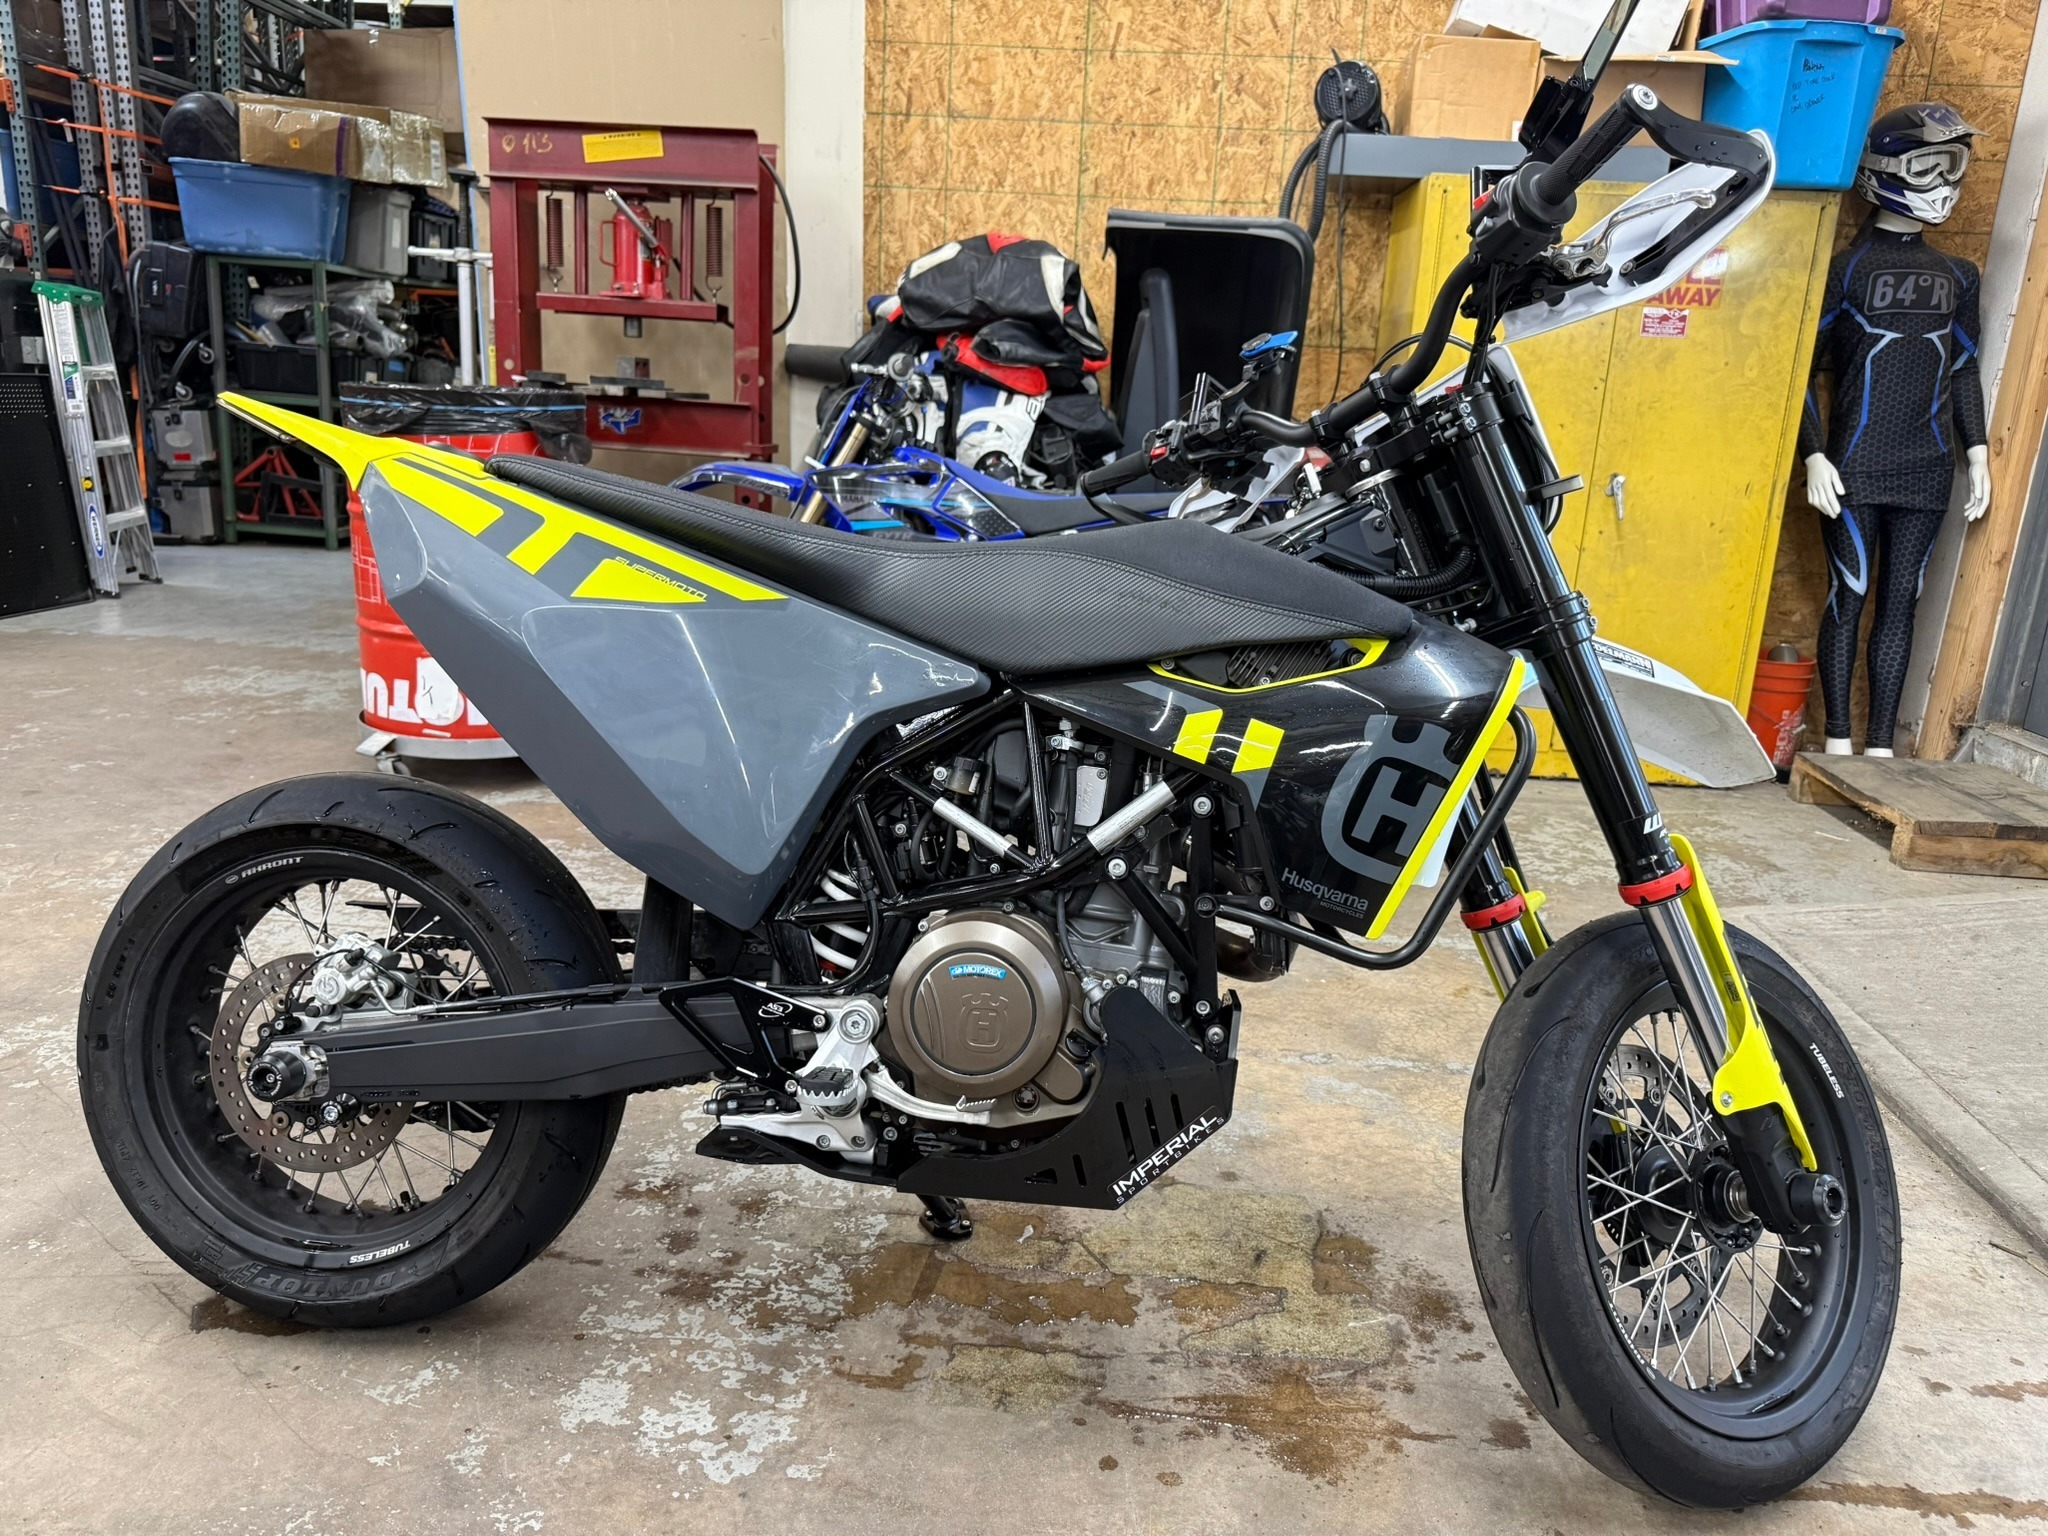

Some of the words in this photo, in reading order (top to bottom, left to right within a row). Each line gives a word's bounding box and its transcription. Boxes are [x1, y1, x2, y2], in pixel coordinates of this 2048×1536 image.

[615, 555, 708, 601] SUPERMOTO
[1281, 867, 1369, 911] Husqvarna
[1320, 900, 1364, 919] MOTORCYCLES
[964, 965, 1002, 978] MOTOREX
[1809, 1042, 1845, 1099] TUBELESS
[1113, 1116, 1217, 1196] IMPERIAL
[1116, 1116, 1225, 1204] SPORTBIKES
[349, 1239, 411, 1264] TUBELESS
[254, 1270, 397, 1298] DUNLOP
